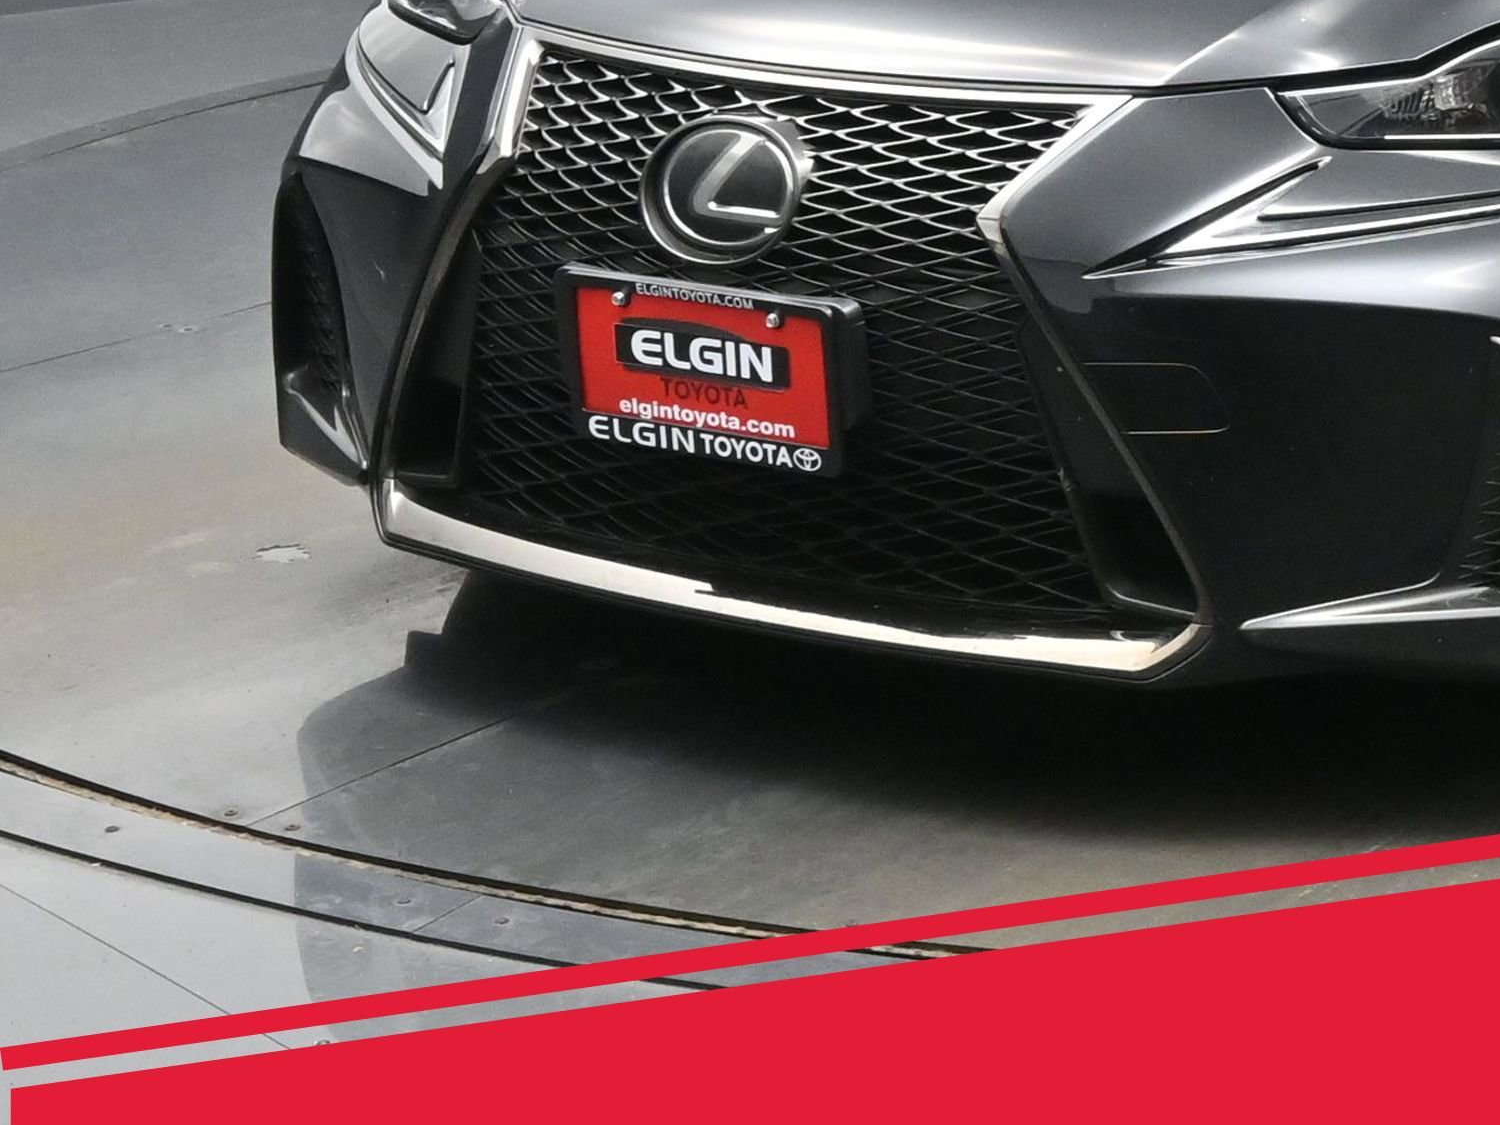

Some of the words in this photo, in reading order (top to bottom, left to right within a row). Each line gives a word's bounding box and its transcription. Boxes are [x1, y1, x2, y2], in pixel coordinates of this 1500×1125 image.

[635, 283, 754, 310] ELGINTOYOTA.COM
[630, 329, 774, 383] ELGIN
[660, 377, 748, 409] TOYOTA
[619, 398, 795, 438] elgintoyota.com
[588, 415, 695, 453] ELGIN
[699, 433, 793, 468] TOYOTA
